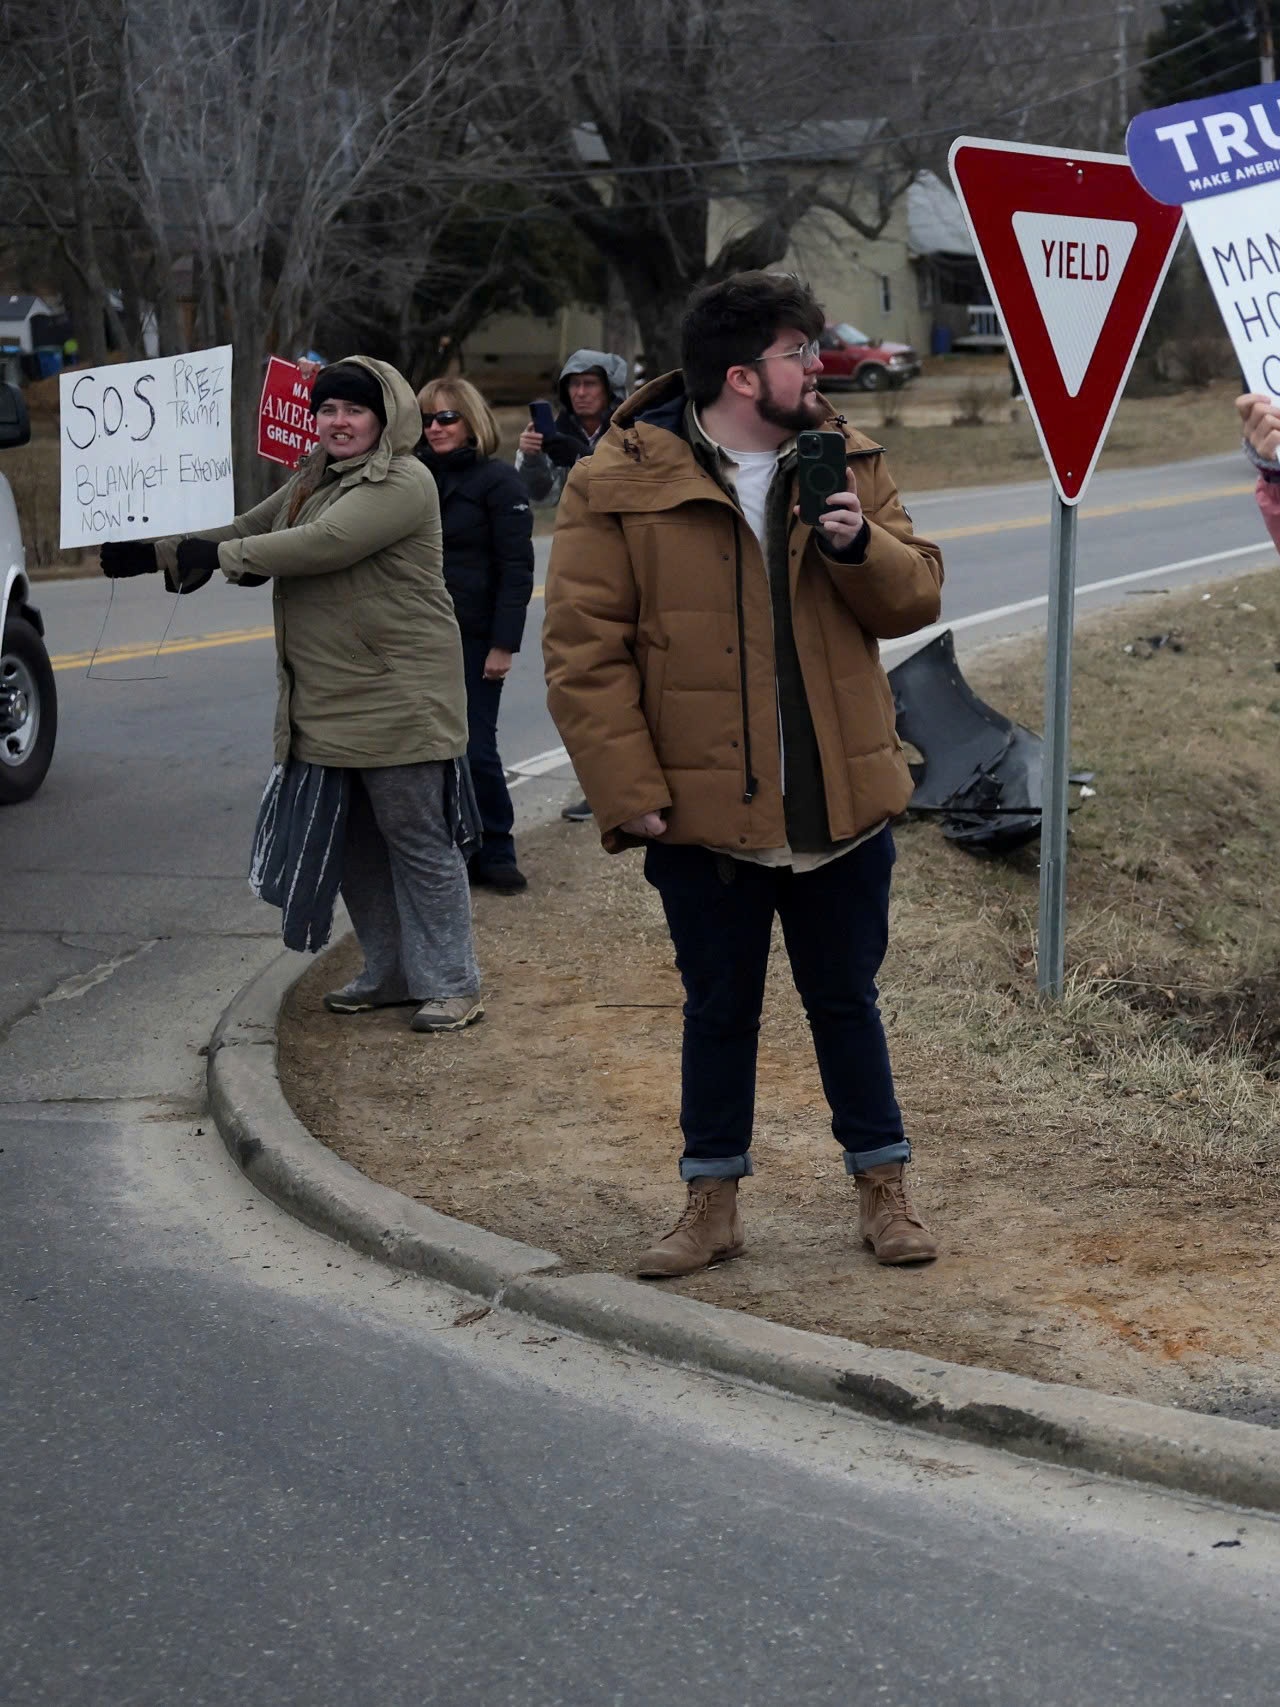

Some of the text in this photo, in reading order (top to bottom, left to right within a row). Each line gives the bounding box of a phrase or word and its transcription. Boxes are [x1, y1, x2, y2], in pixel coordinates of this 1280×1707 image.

[1189, 173, 1231, 192] MAKE
[1041, 239, 1110, 282] YIELD
[266, 424, 303, 450] GREAT
